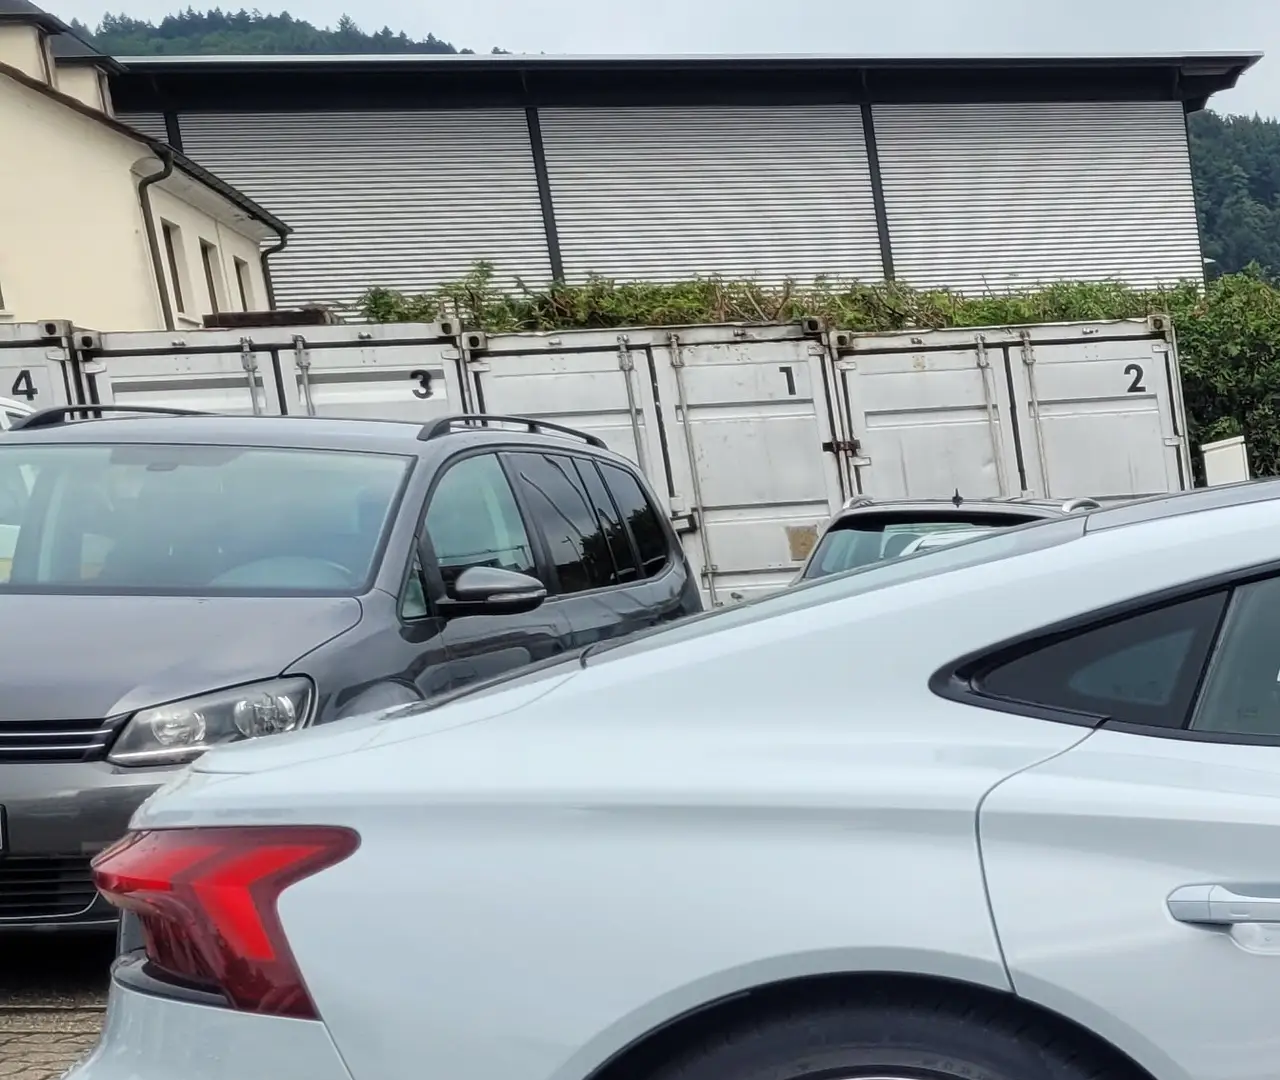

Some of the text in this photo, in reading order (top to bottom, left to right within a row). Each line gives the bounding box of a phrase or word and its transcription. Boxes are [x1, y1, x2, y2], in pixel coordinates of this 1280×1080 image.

[12, 369, 38, 401] 4
[410, 370, 433, 399] 3
[779, 366, 797, 395] 1
[1123, 363, 1147, 393] 2
